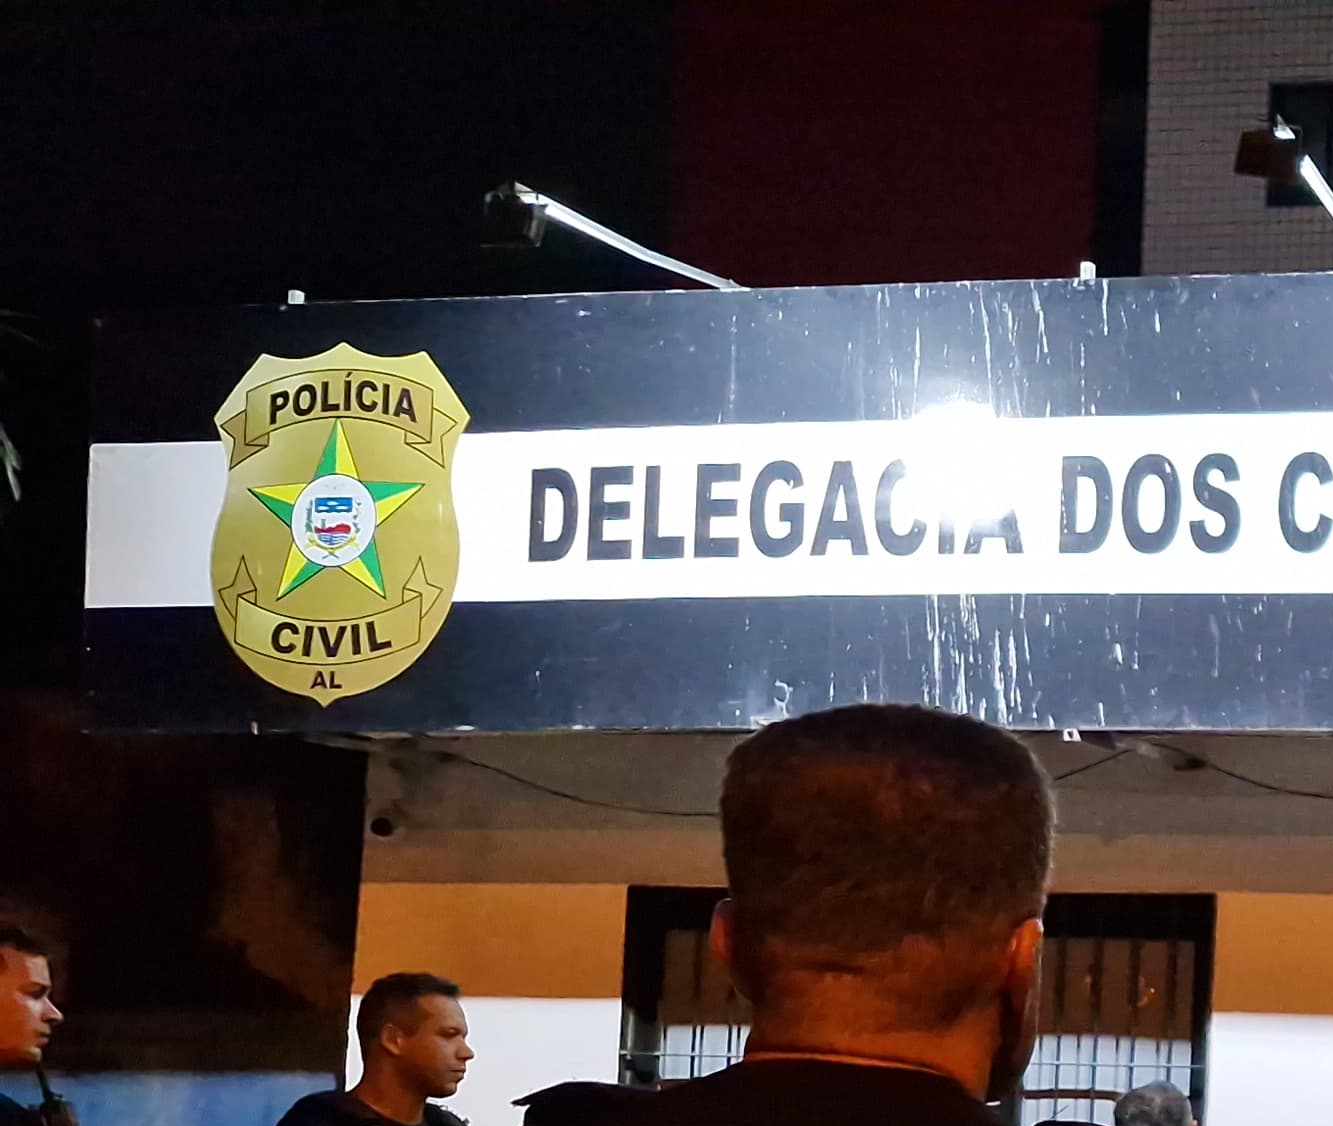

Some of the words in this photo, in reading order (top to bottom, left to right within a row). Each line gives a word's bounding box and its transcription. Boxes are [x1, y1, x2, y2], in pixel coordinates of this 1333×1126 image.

[270, 373, 416, 425] POLÍCIA
[1060, 453, 1240, 553] DOS
[271, 622, 392, 657] CIVIL
[310, 671, 342, 689] AL
